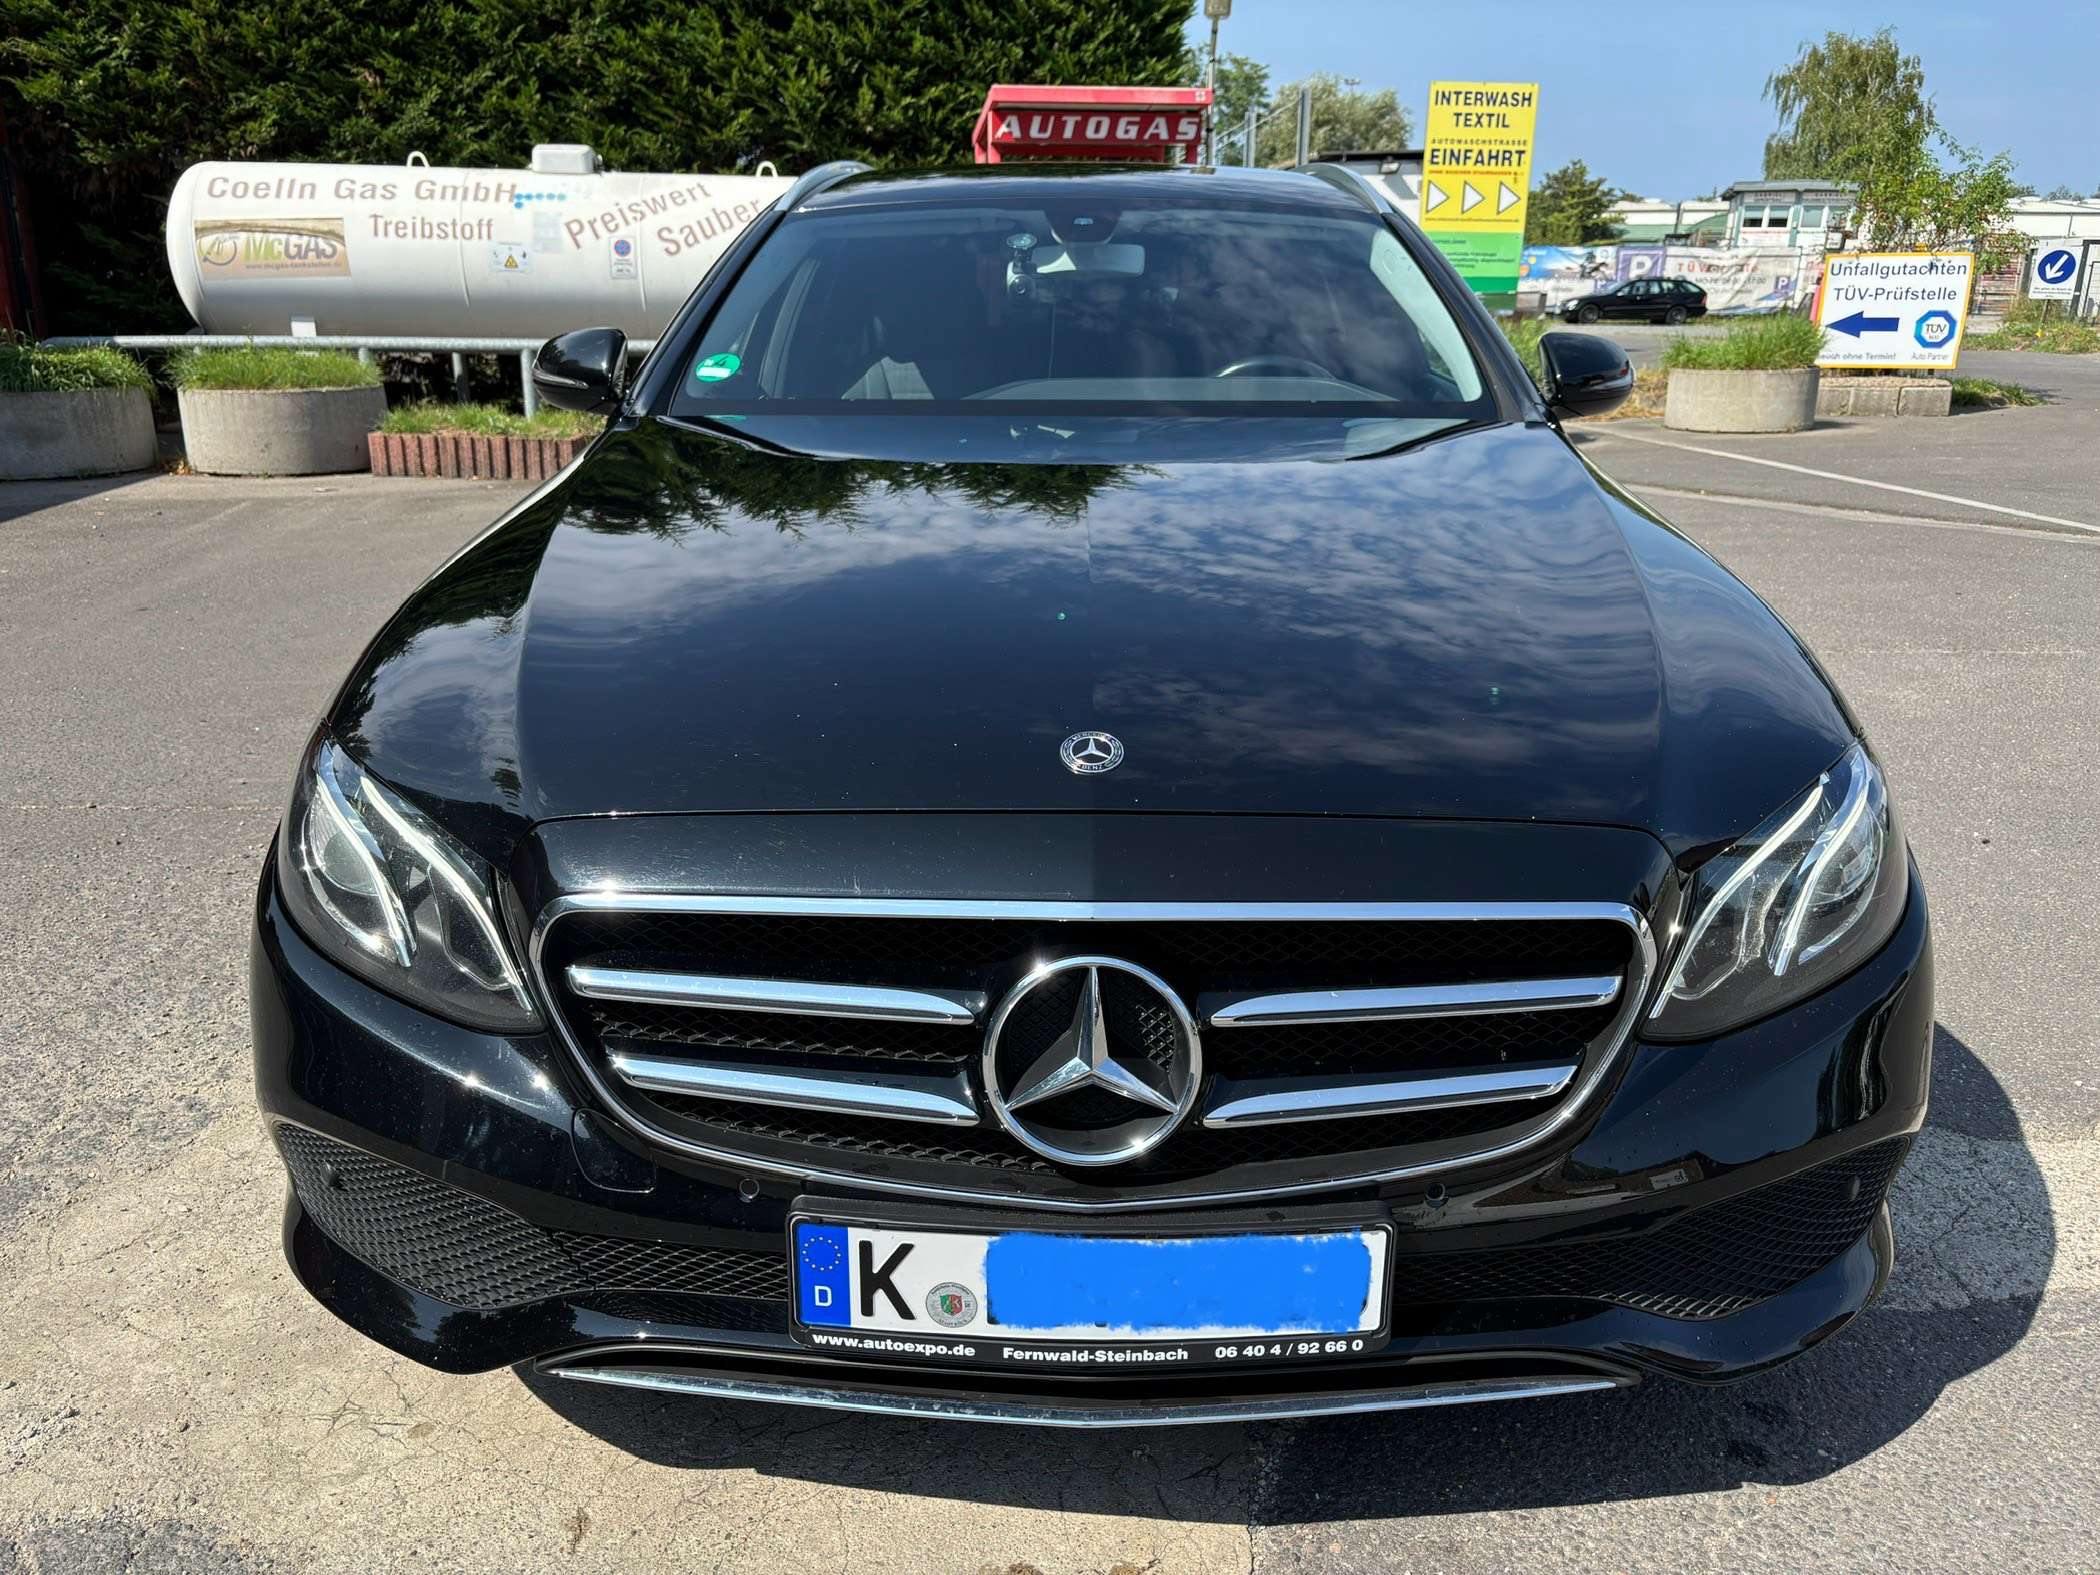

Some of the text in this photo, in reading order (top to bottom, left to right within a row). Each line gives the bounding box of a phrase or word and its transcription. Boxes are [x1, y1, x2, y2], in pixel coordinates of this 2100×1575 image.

[1434, 90, 1533, 107] INTERWASH
[994, 114, 1200, 140] AUTOGAS
[1453, 112, 1511, 128] TEXTIL
[1429, 148, 1526, 167] EINFAHRT
[207, 176, 517, 203] Coelln Gas GmbH
[564, 181, 712, 250] Preiswert
[369, 213, 494, 241] Treibstoff
[656, 199, 762, 257] Sauber
[1830, 261, 1968, 279] Unfallgutachten
[1834, 284, 1957, 302] TÜV-Prüfstelle
[1925, 323, 1947, 334] TÜV
[1843, 353, 1863, 361] ohne
[1866, 352, 1896, 361] Termin!
[858, 1239, 916, 1321] K
[814, 1285, 832, 1307] D
[812, 1333, 976, 1357] www.autoexpo.de
[1003, 1346, 1188, 1363] Fernwald-Steinbach
[1215, 1339, 1364, 1359] 06 40 4 / 92 66 0
